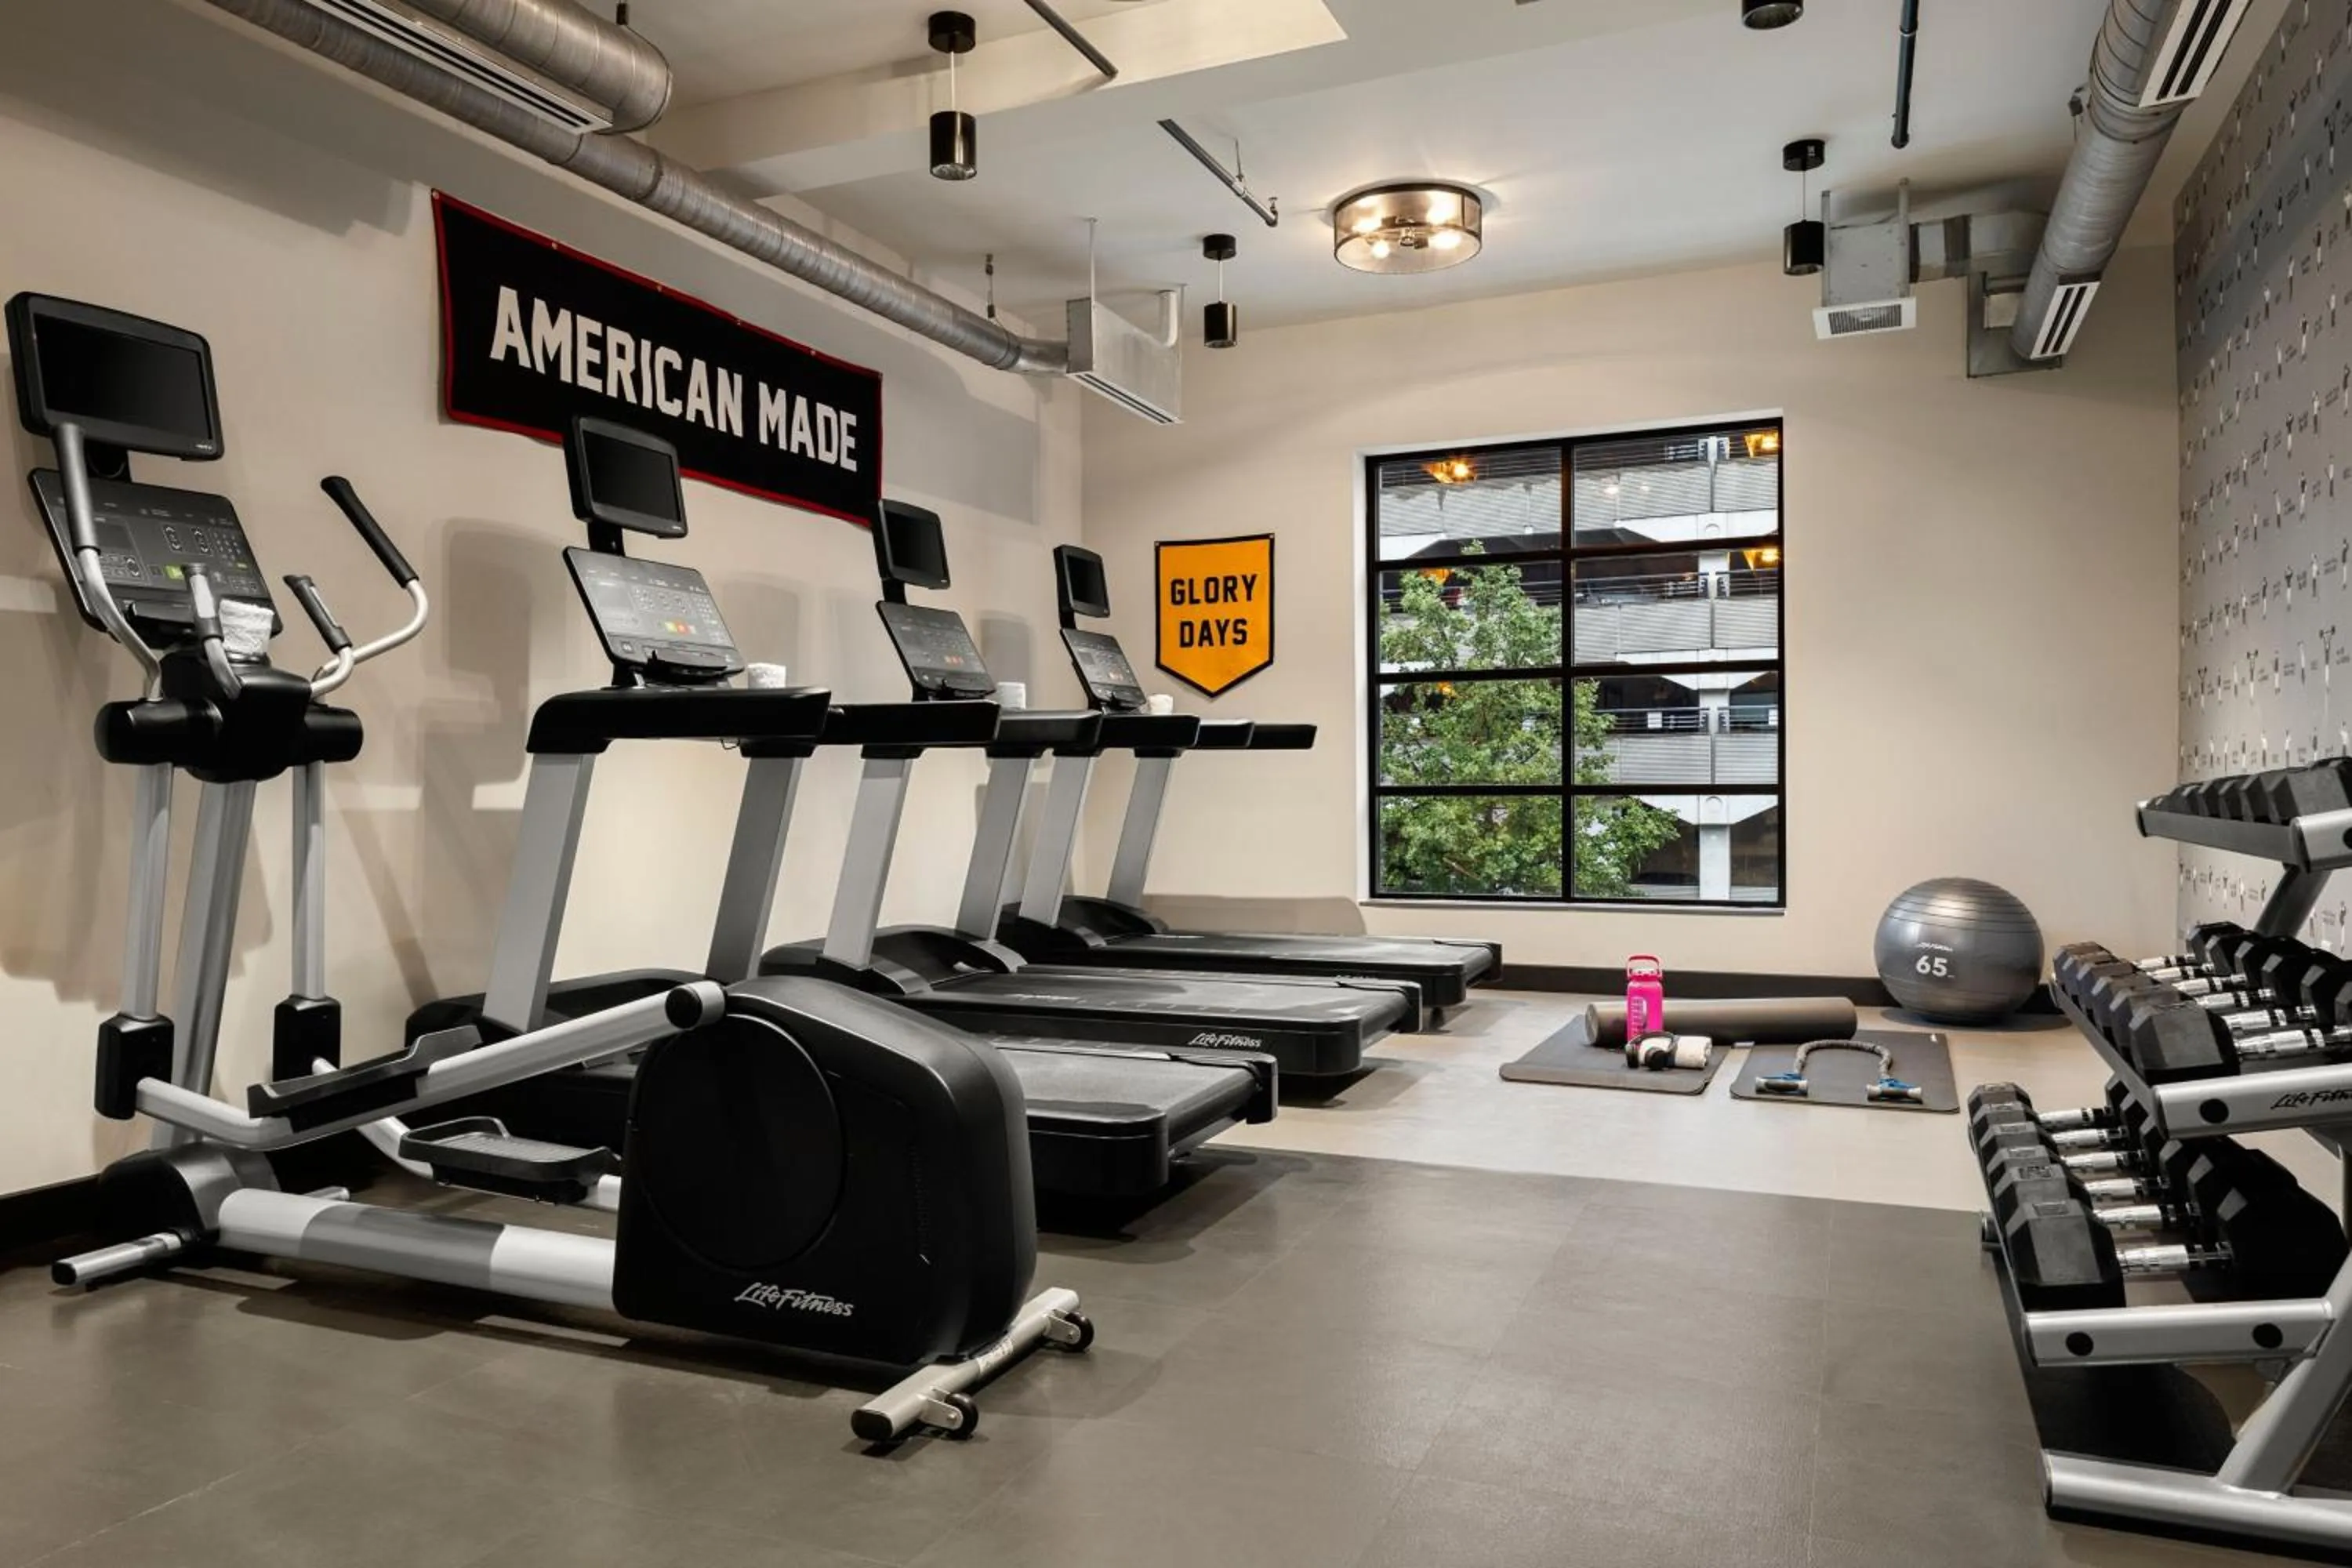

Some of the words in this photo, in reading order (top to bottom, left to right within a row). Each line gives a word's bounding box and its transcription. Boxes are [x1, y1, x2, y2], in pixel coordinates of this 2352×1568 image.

[490, 285, 743, 437] AMERICAN
[758, 381, 857, 472] MADE
[1171, 574, 1258, 605] GLORY
[1179, 619, 1247, 648] DAYS
[1916, 955, 1947, 977] 65
